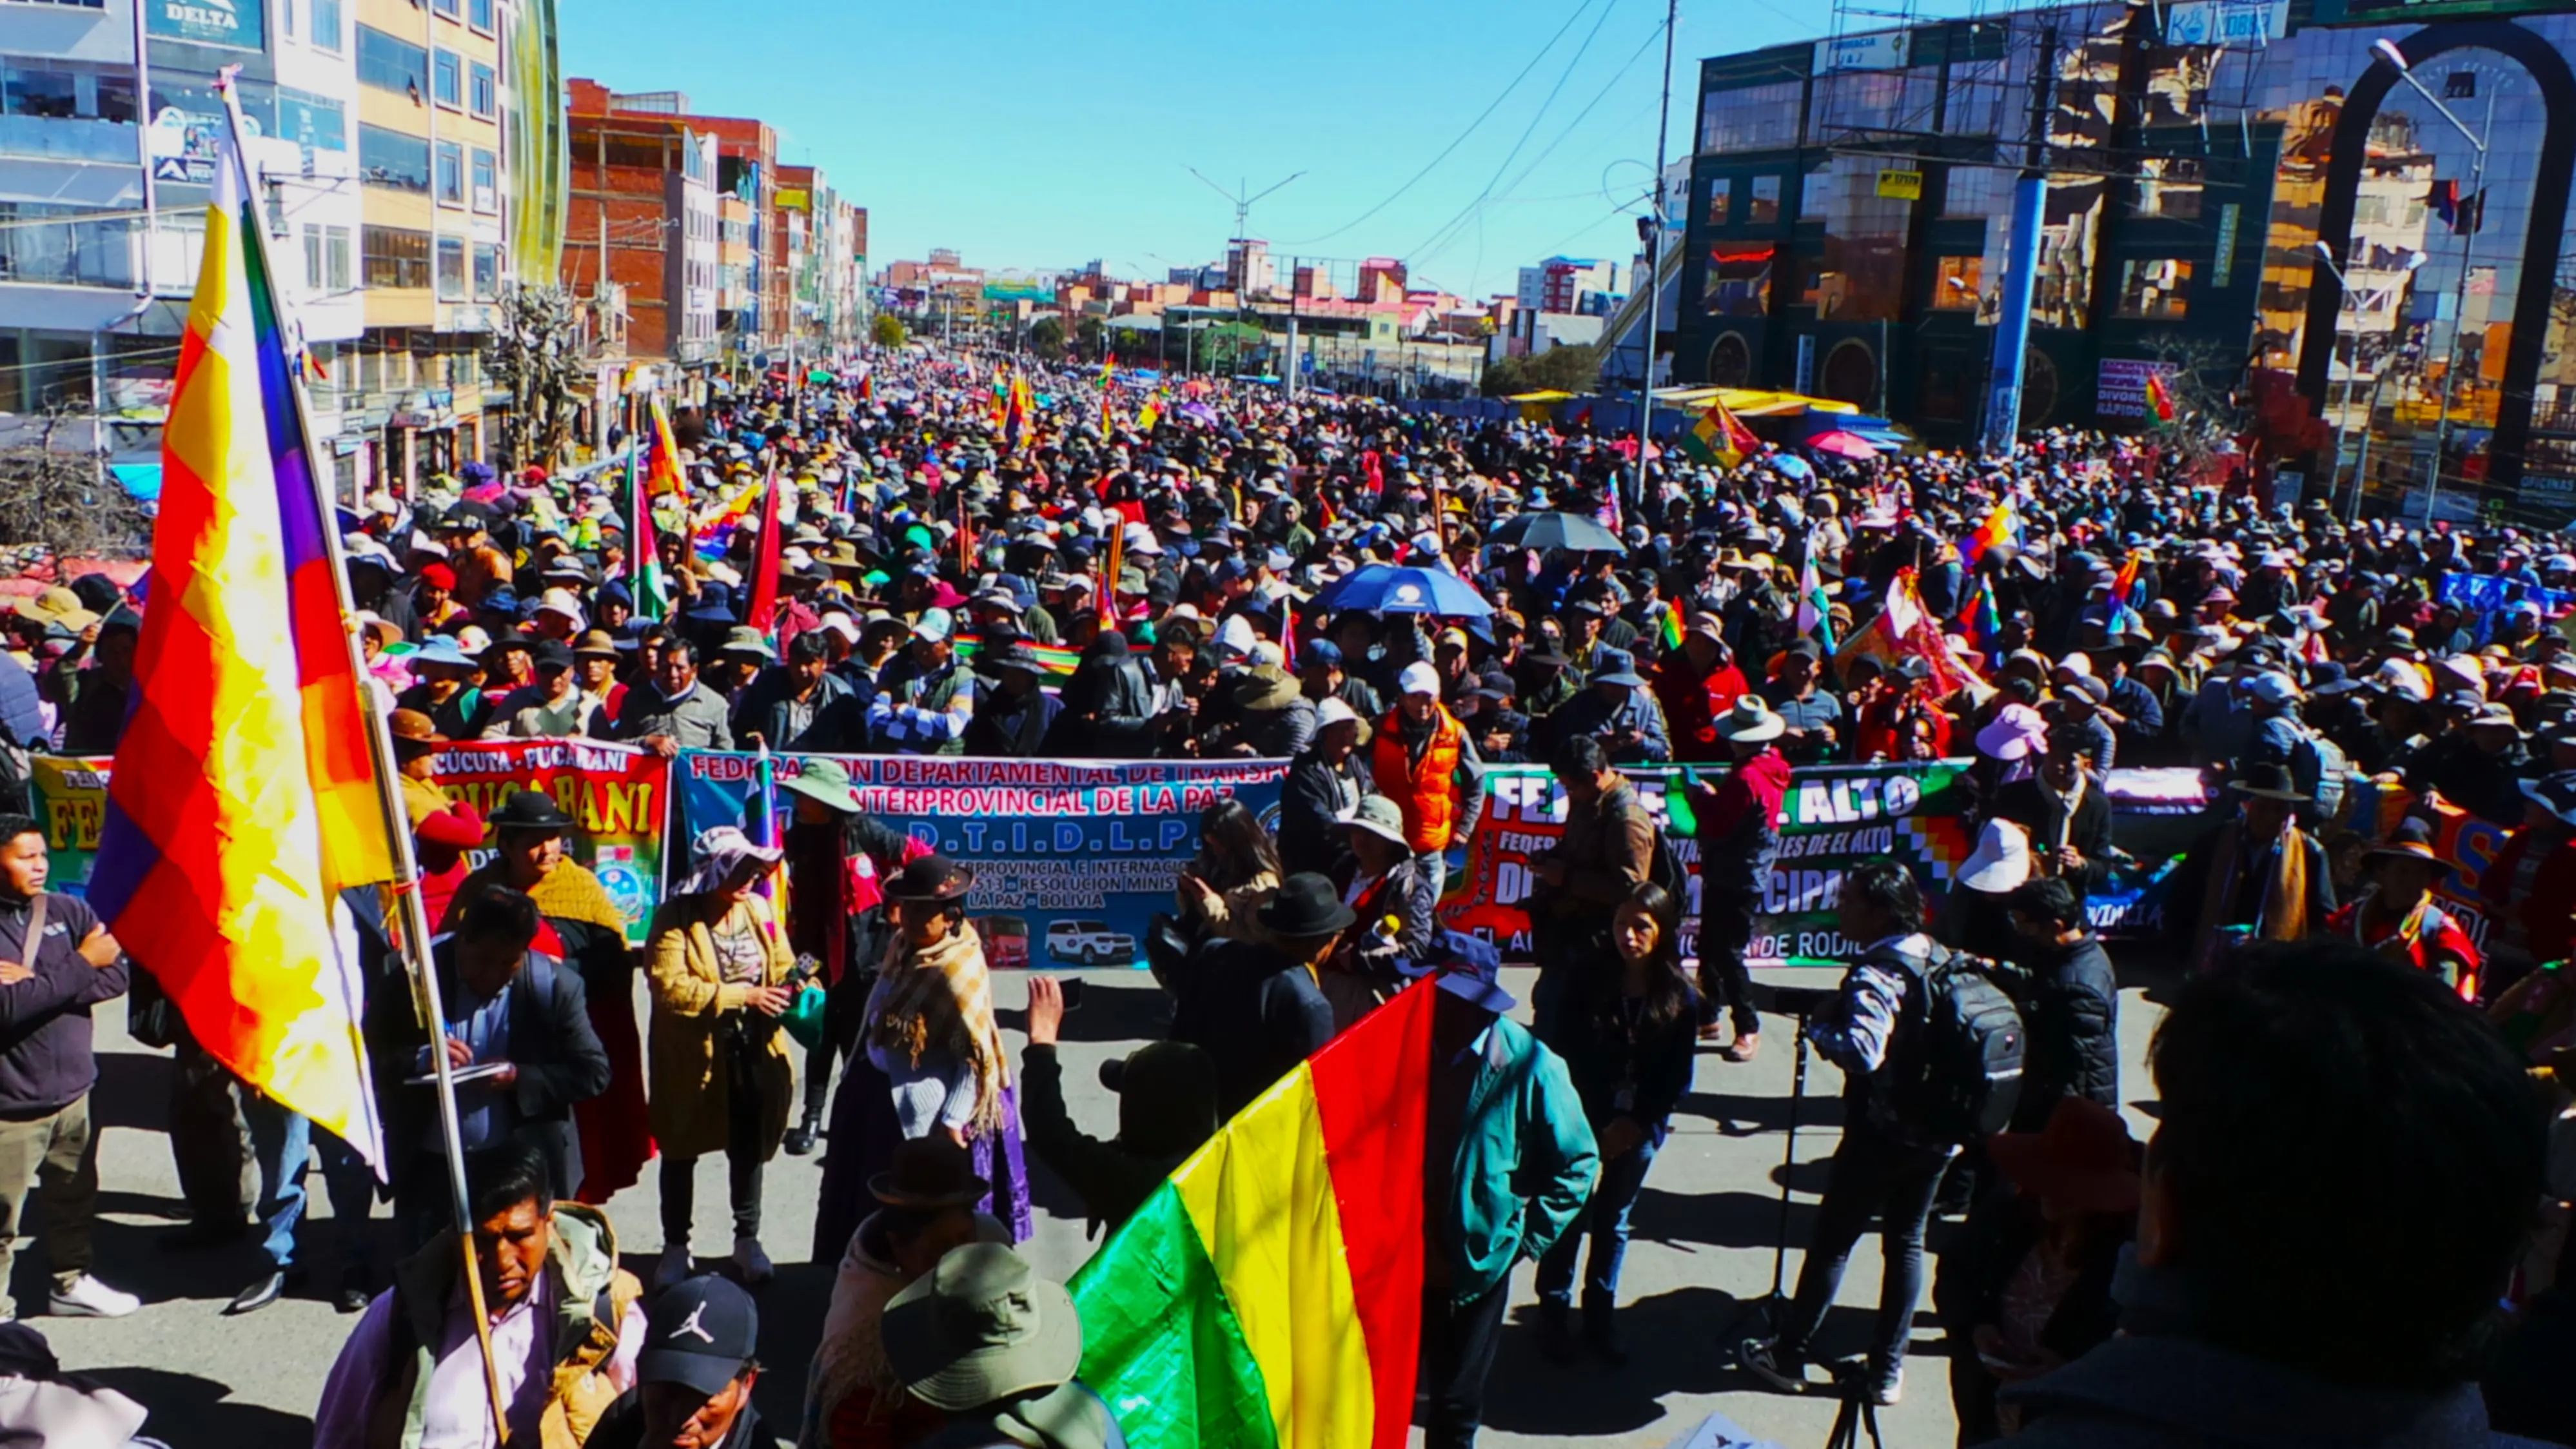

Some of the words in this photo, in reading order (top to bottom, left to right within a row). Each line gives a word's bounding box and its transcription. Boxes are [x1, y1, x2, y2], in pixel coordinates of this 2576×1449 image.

[166, 3, 239, 30] DELTA
[524, 745, 627, 772] PUCARANI
[881, 759, 1122, 786] DEPARTAMENTAL
[1127, 765, 1168, 785] DE
[1094, 785, 1135, 816] DE
[1141, 787, 1177, 814] LA
[1799, 776, 1920, 823] ALTO
[1806, 832, 1832, 856] DE
[1830, 831, 1851, 854] EL
[1851, 827, 1892, 853] ALTO
[1018, 878, 1121, 893] RESOLUCION
[967, 893, 992, 909] LA
[994, 893, 1025, 909] PAZ
[1037, 892, 1106, 909] BOLIVIA
[1760, 933, 1792, 958] DE
